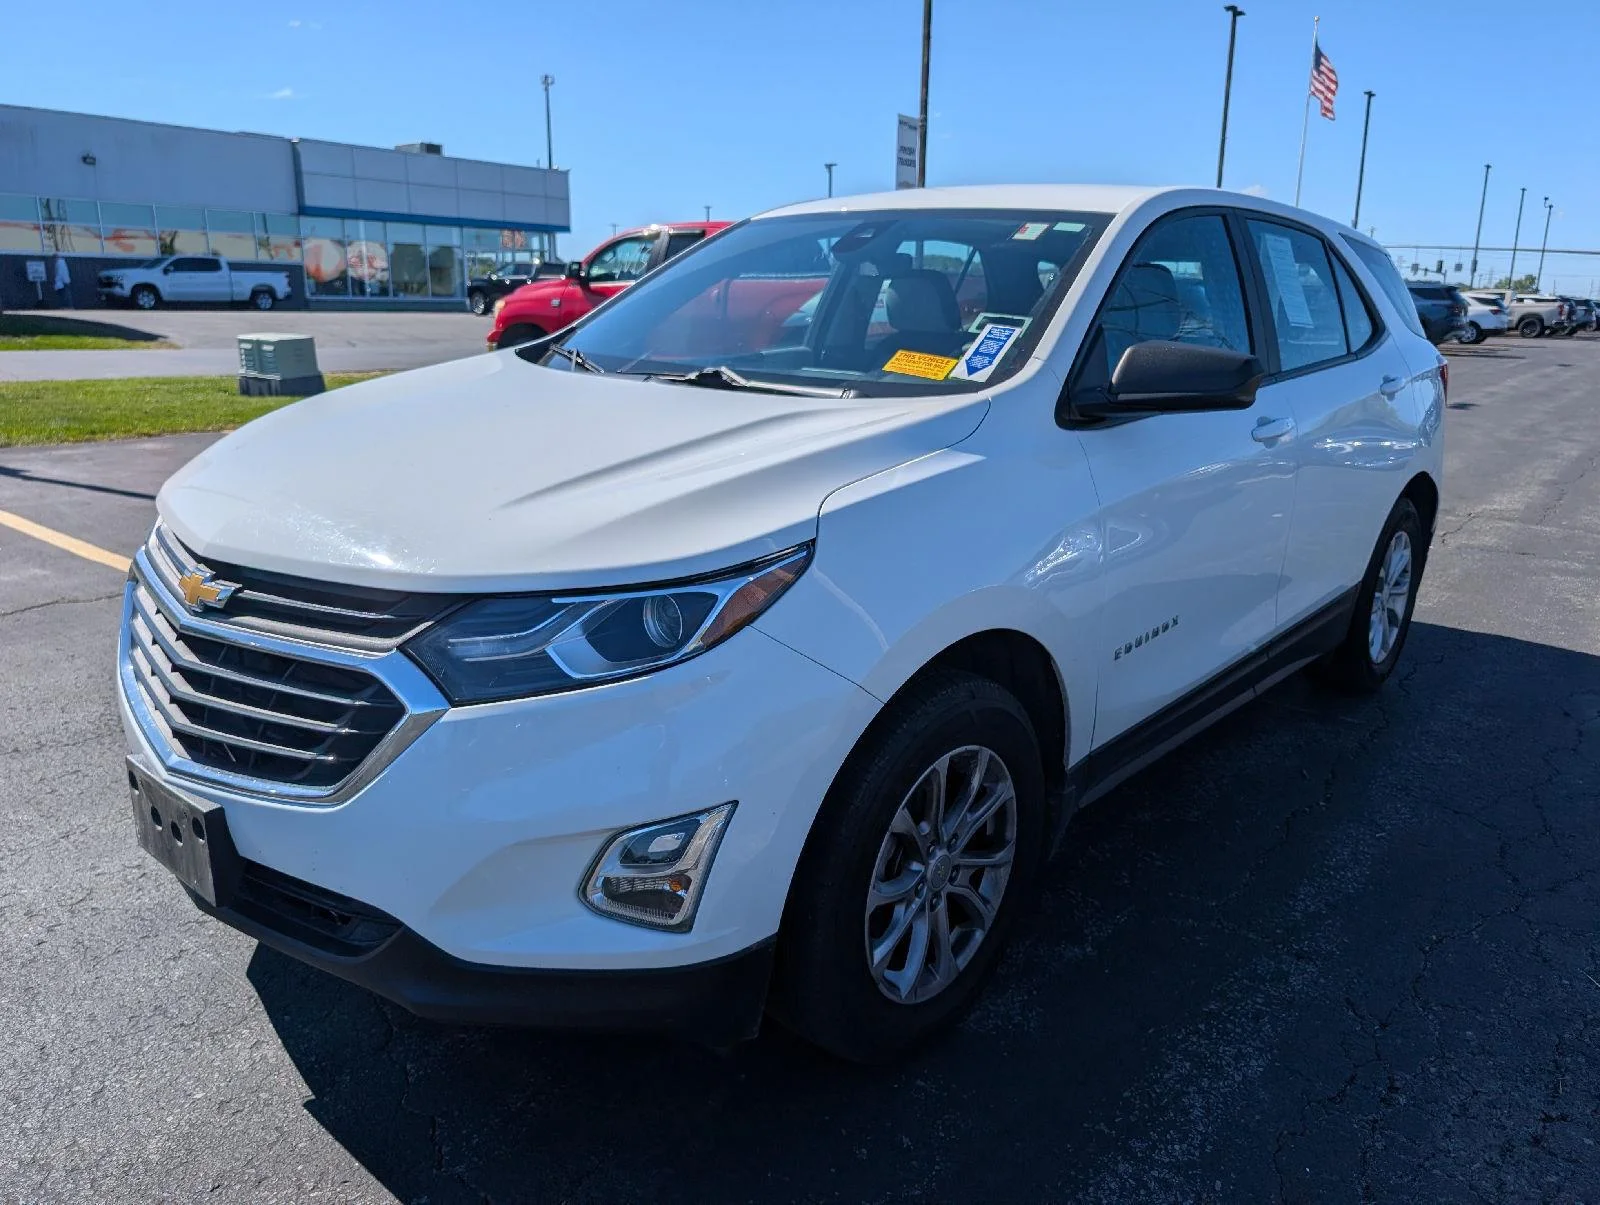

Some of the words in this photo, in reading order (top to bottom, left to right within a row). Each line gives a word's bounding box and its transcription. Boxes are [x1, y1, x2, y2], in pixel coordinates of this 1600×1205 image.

[899, 352, 916, 360] THIS
[918, 355, 952, 366] VEHICLE
[1113, 614, 1179, 661] EQUINOX
